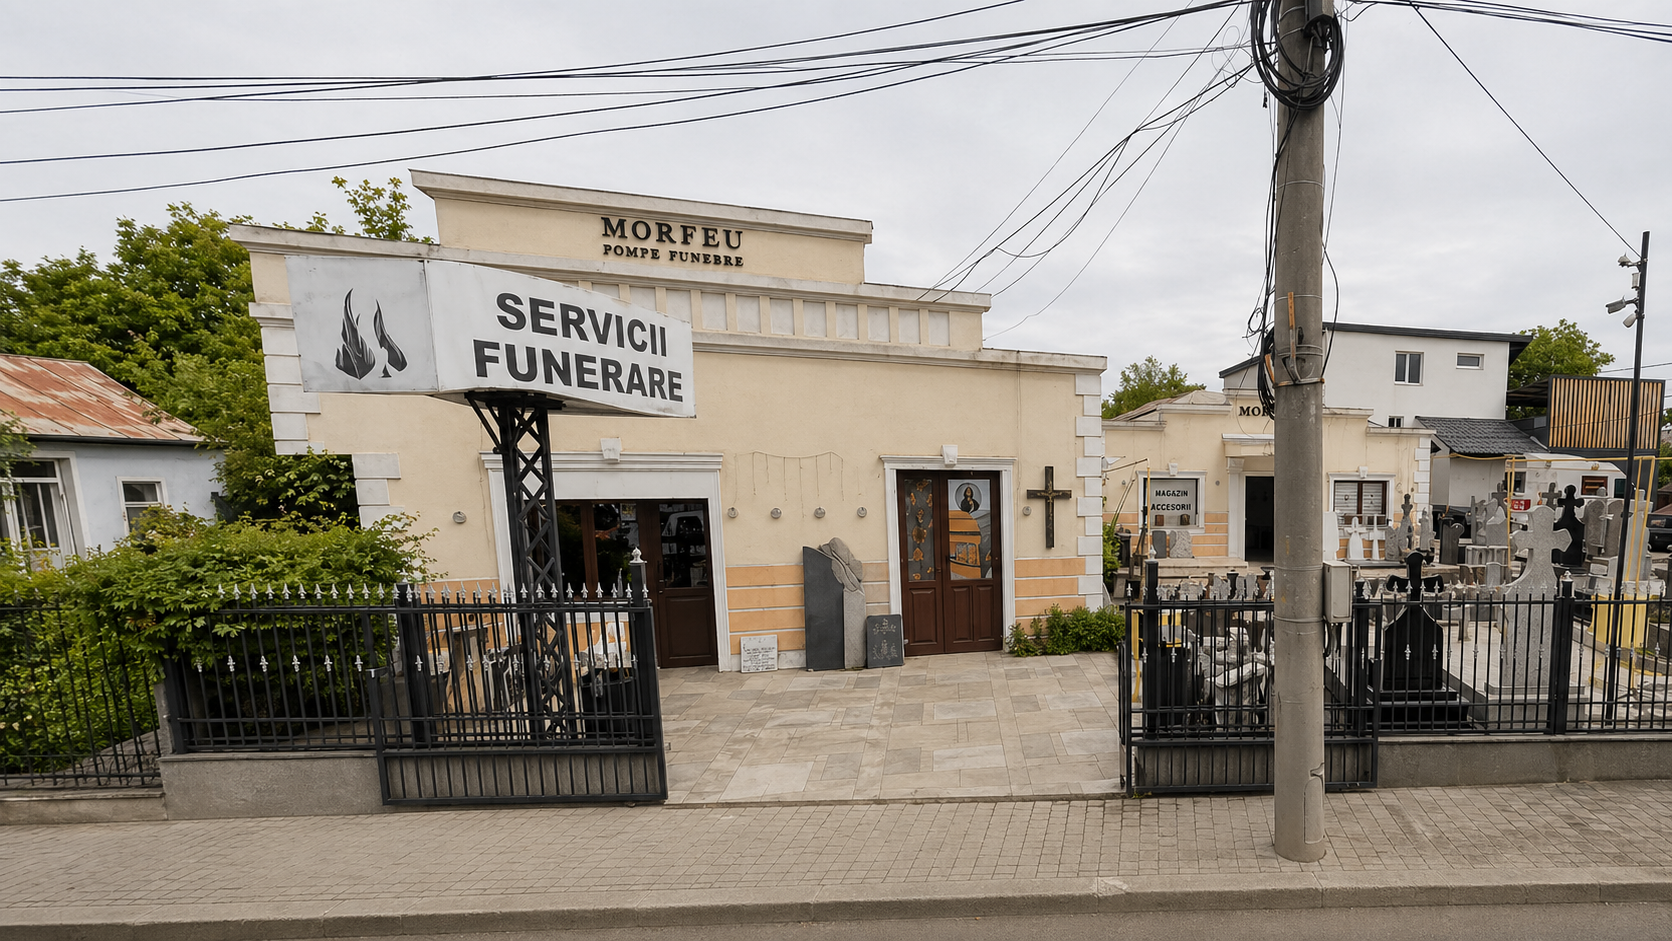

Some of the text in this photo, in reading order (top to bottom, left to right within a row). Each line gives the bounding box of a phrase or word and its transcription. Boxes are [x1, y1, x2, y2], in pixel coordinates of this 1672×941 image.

[601, 217, 743, 249] MORFEU
[603, 244, 744, 267] POMPE FUNEBRE
[496, 292, 668, 357] SERVICII
[472, 339, 683, 403] FUNERARE
[1155, 489, 1188, 497] MAGAZIN
[1150, 503, 1191, 511] ACCESORII
